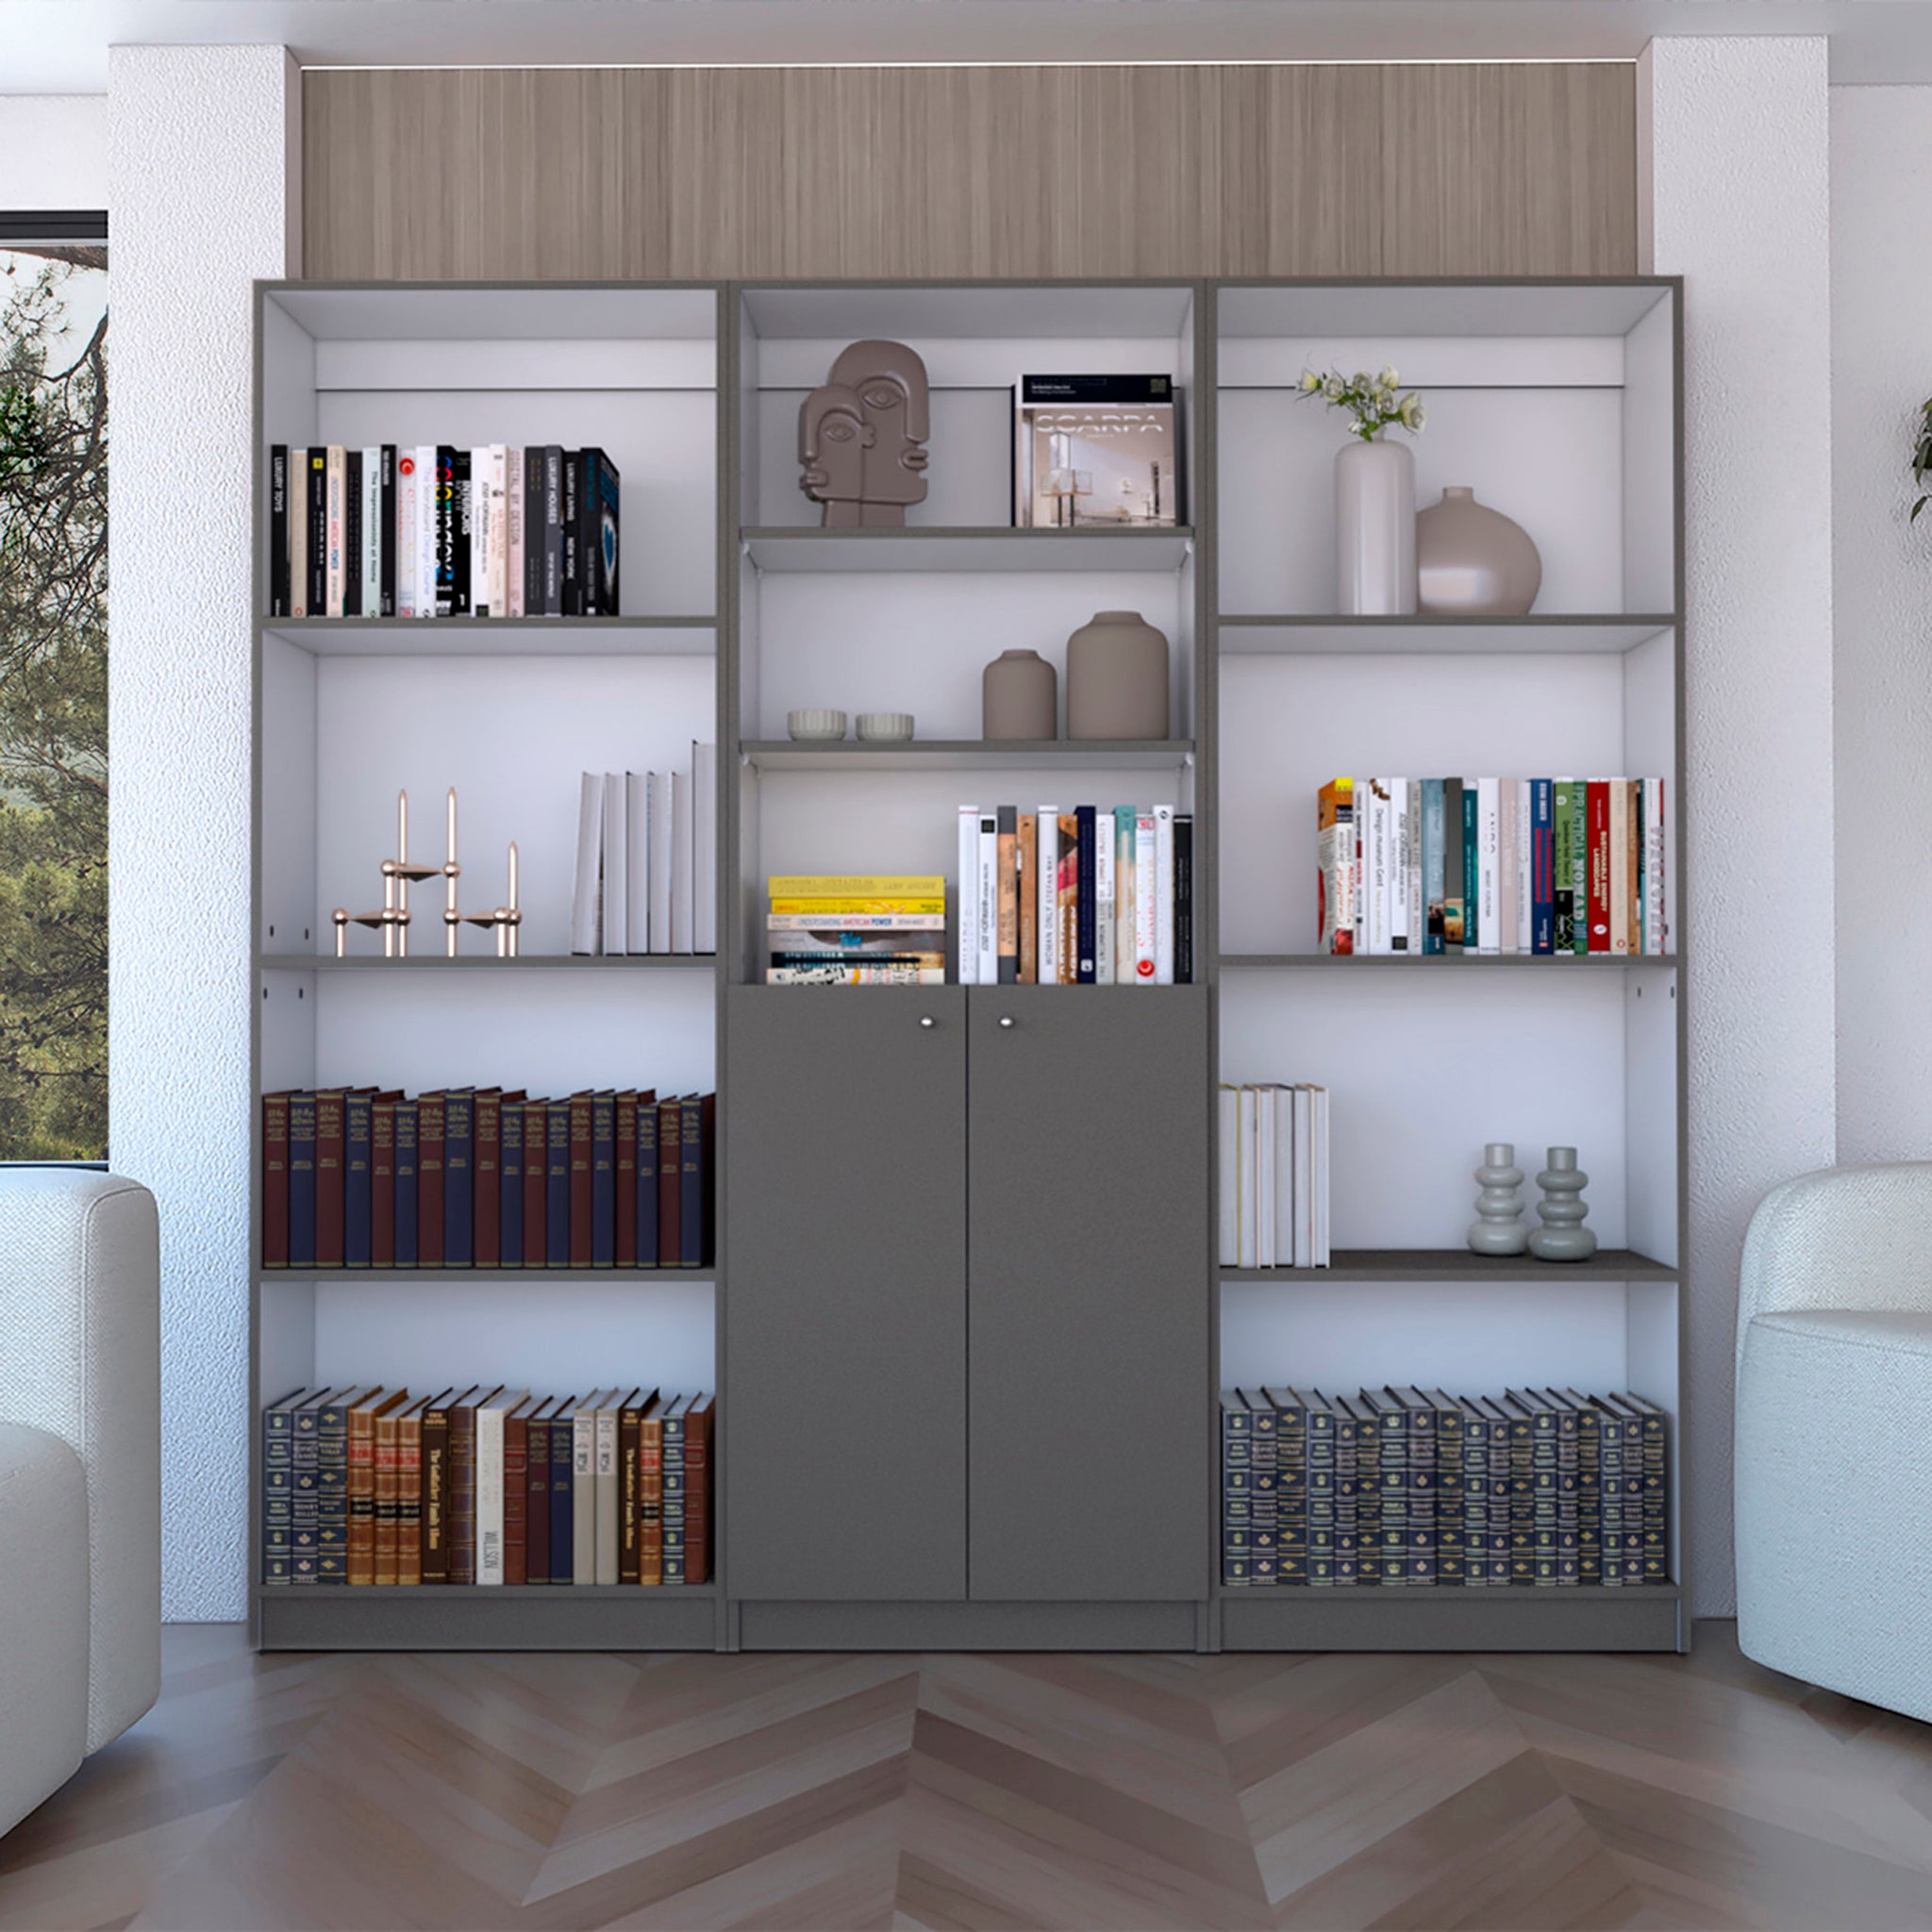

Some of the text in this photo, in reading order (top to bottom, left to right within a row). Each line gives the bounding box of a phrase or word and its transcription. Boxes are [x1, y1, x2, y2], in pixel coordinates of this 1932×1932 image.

[1037, 414, 1163, 433] SCARPA
[275, 457, 283, 512] LUXURY TOYS
[510, 493, 520, 505] BY
[548, 457, 557, 525] LUXURY HOUSES
[566, 462, 575, 521] LUXURY LIVING
[510, 509, 520, 545] DESIGN
[566, 537, 575, 579] NEW YORK
[1374, 808, 1384, 833] Design
[1574, 791, 1585, 921] PRACTICAL NOMAD
[1375, 869, 1385, 887] Gent
[871, 918, 892, 926] POWER
[1044, 907, 1053, 928] ONLY
[1044, 932, 1053, 966] WOMAN
[430, 1449, 441, 1463] The
[485, 1531, 498, 1569] WILLSON
